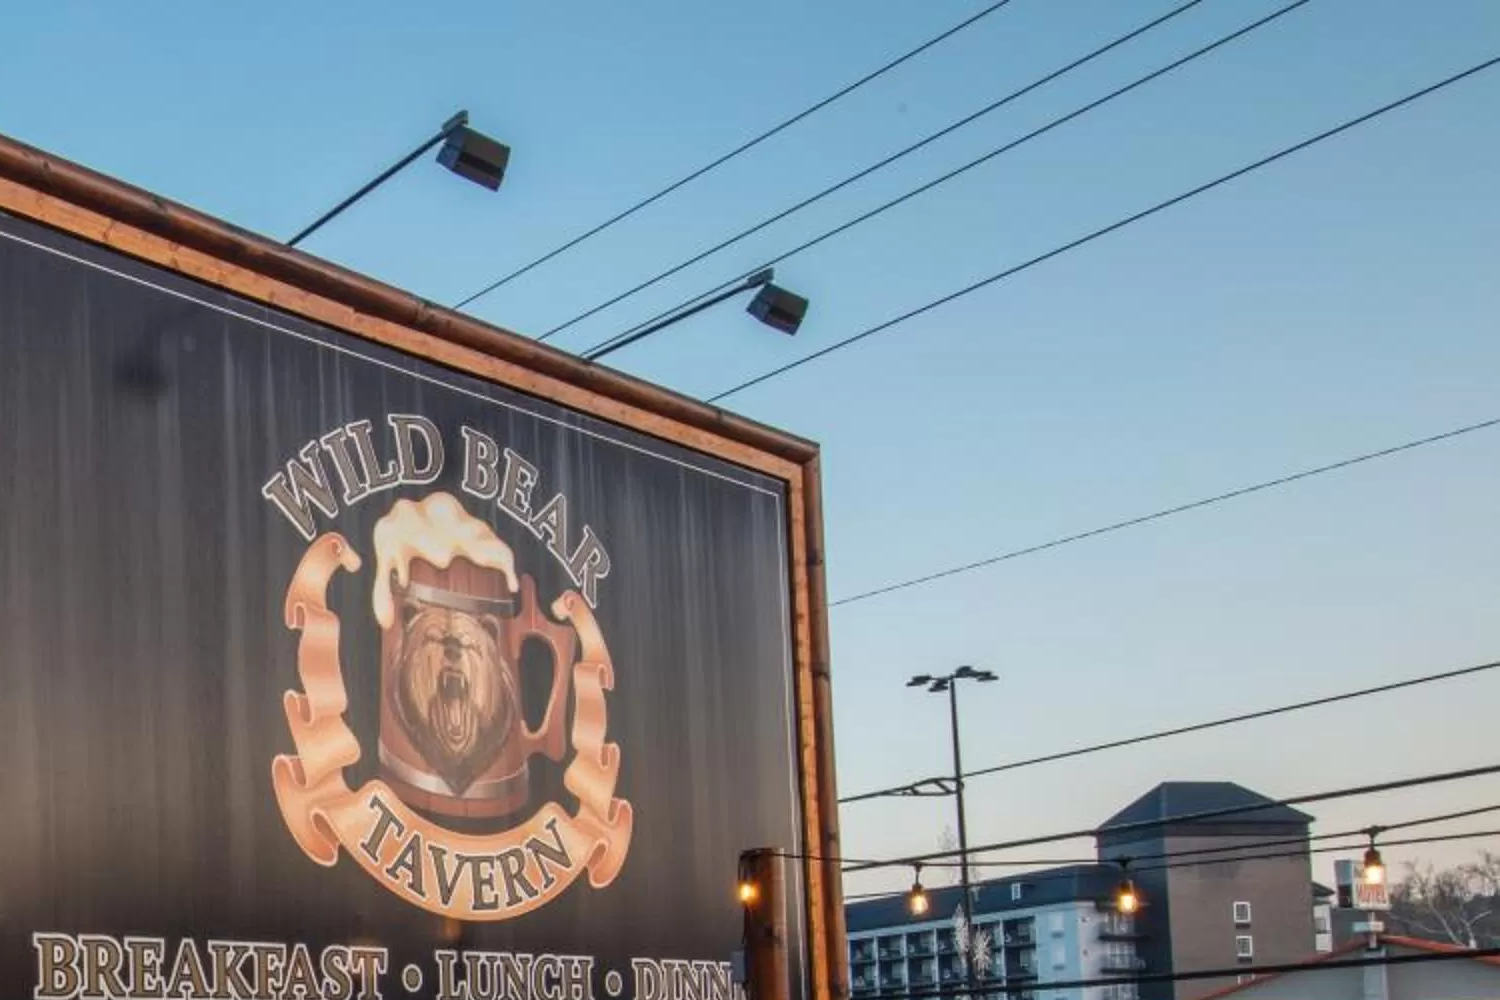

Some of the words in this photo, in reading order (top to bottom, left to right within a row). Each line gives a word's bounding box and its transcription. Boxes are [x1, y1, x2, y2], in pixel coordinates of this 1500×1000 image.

[261, 412, 446, 542] WILD
[461, 425, 611, 609] BEAR
[358, 793, 574, 912] TAVERN
